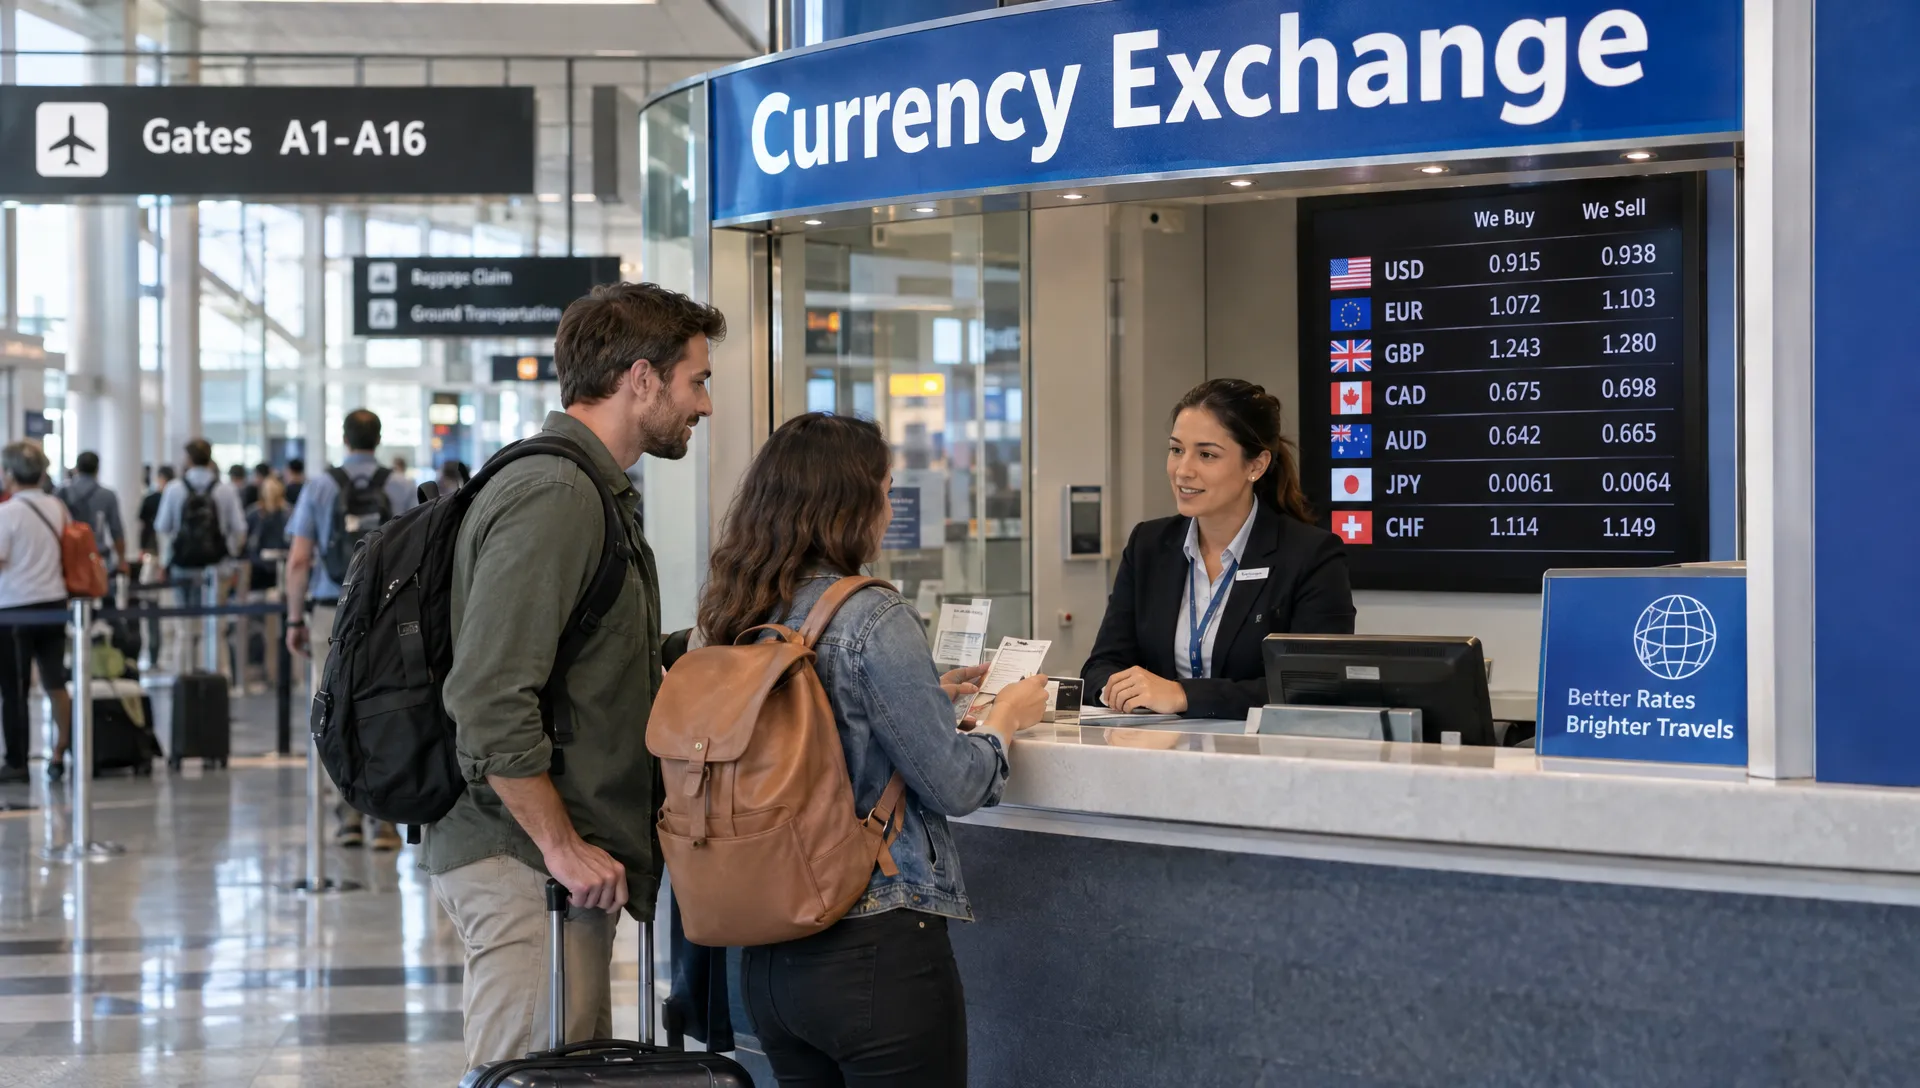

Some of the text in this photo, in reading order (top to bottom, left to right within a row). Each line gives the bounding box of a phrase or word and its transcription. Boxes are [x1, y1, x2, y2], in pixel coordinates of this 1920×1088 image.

[751, 9, 1649, 175] Currency Exchange
[142, 117, 427, 157] Gates A1-A16
[1474, 208, 1536, 229] We Buy
[1582, 197, 1647, 220] We Sell
[1384, 243, 1657, 281] USD 0.915 0.938
[411, 267, 512, 289] Baggage Claim
[410, 303, 562, 325] Ground Transportation
[1384, 287, 1657, 322] EUR 1.072 1.103
[1384, 332, 1657, 364] GBP 1.243 1.280
[1384, 377, 1657, 406] CAD 0.675 0.698
[1384, 422, 1657, 451] AUD 0.642 0.665
[1385, 471, 1673, 495] JPY 0.0061 0.0064
[1384, 516, 1657, 538] CHF 1.114 1.149
[1567, 688, 1697, 710] Better Rates
[1566, 714, 1734, 740] Brighter Travels
